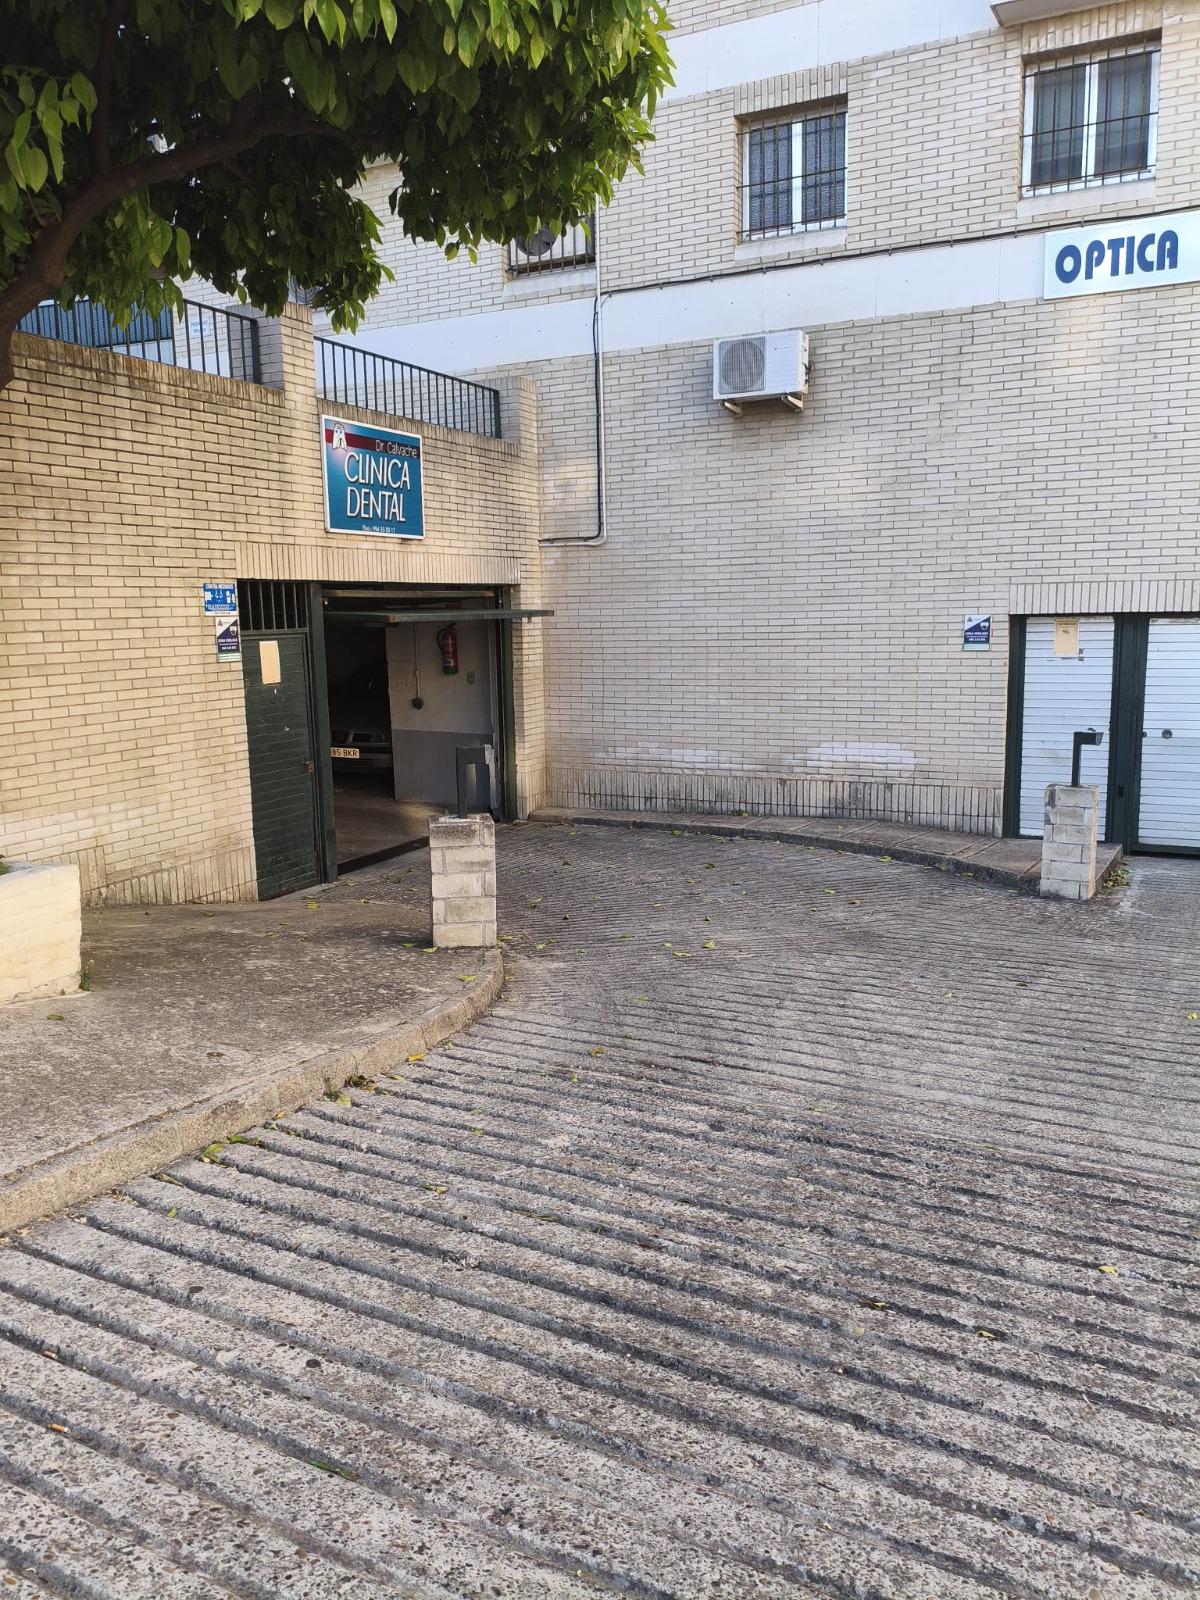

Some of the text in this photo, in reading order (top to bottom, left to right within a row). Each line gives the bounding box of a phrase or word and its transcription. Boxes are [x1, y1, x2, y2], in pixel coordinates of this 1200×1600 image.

[1055, 230, 1179, 284] OPTICA
[375, 439, 417, 459] Dr. Calvache
[344, 452, 411, 490] CLINICA
[346, 486, 406, 522] DENTAL
